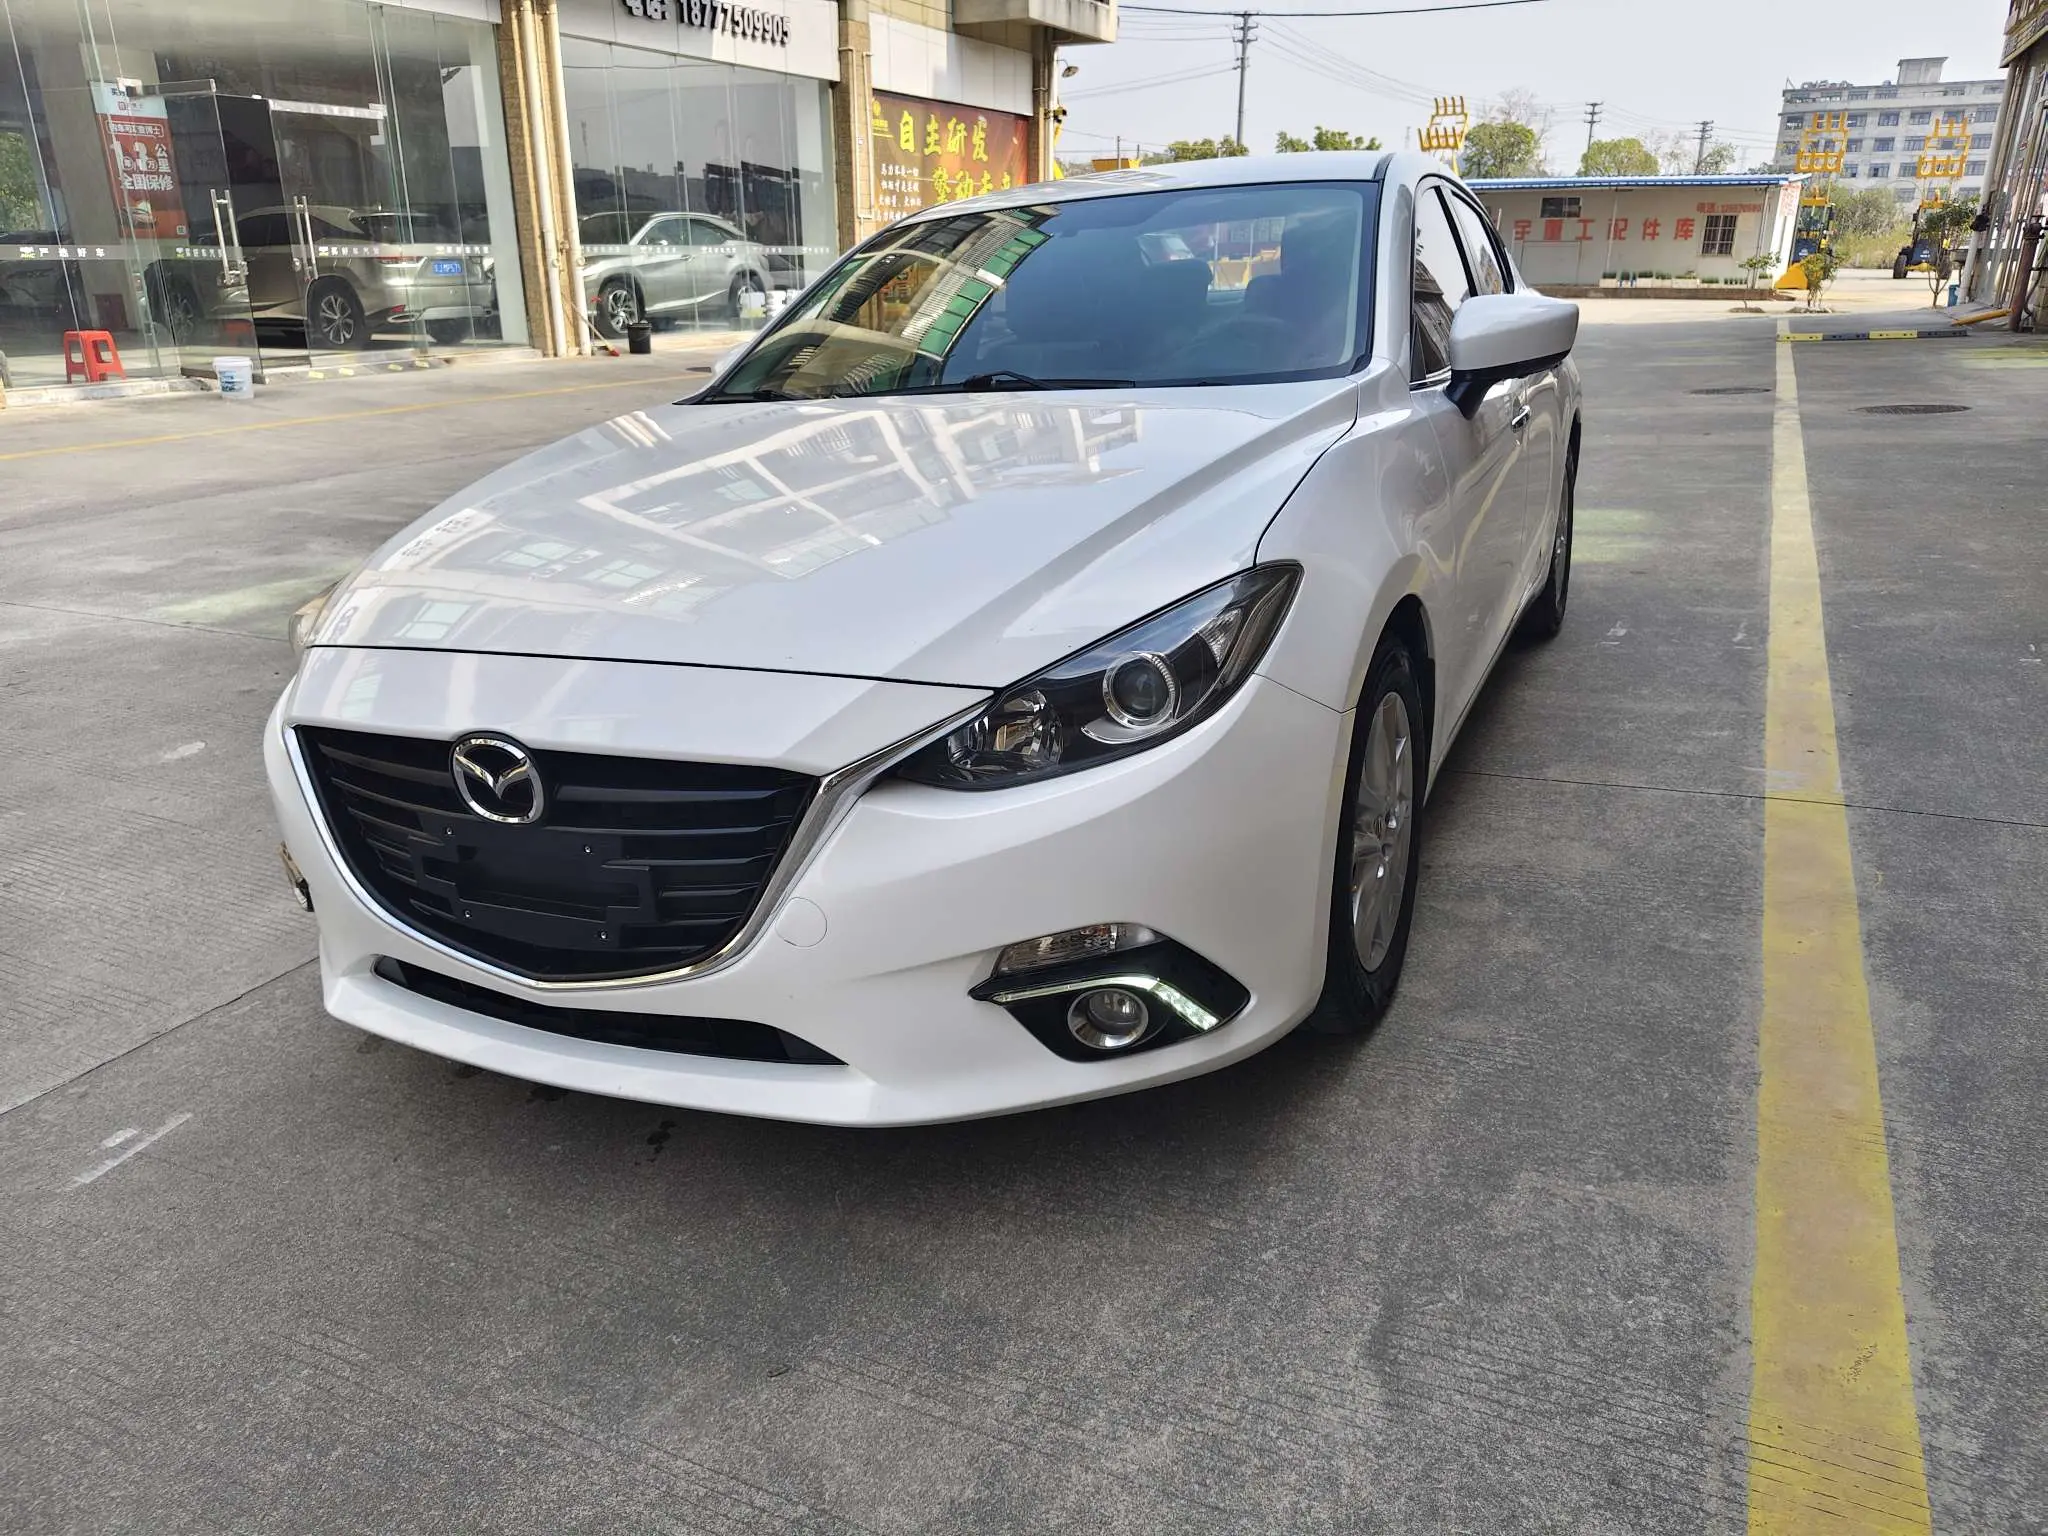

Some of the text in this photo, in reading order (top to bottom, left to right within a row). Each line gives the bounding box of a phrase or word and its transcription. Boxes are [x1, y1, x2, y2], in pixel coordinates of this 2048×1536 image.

[680, 0, 792, 45] 18777509905
[900, 110, 989, 162] 自主研发
[119, 173, 174, 191] 全国保修
